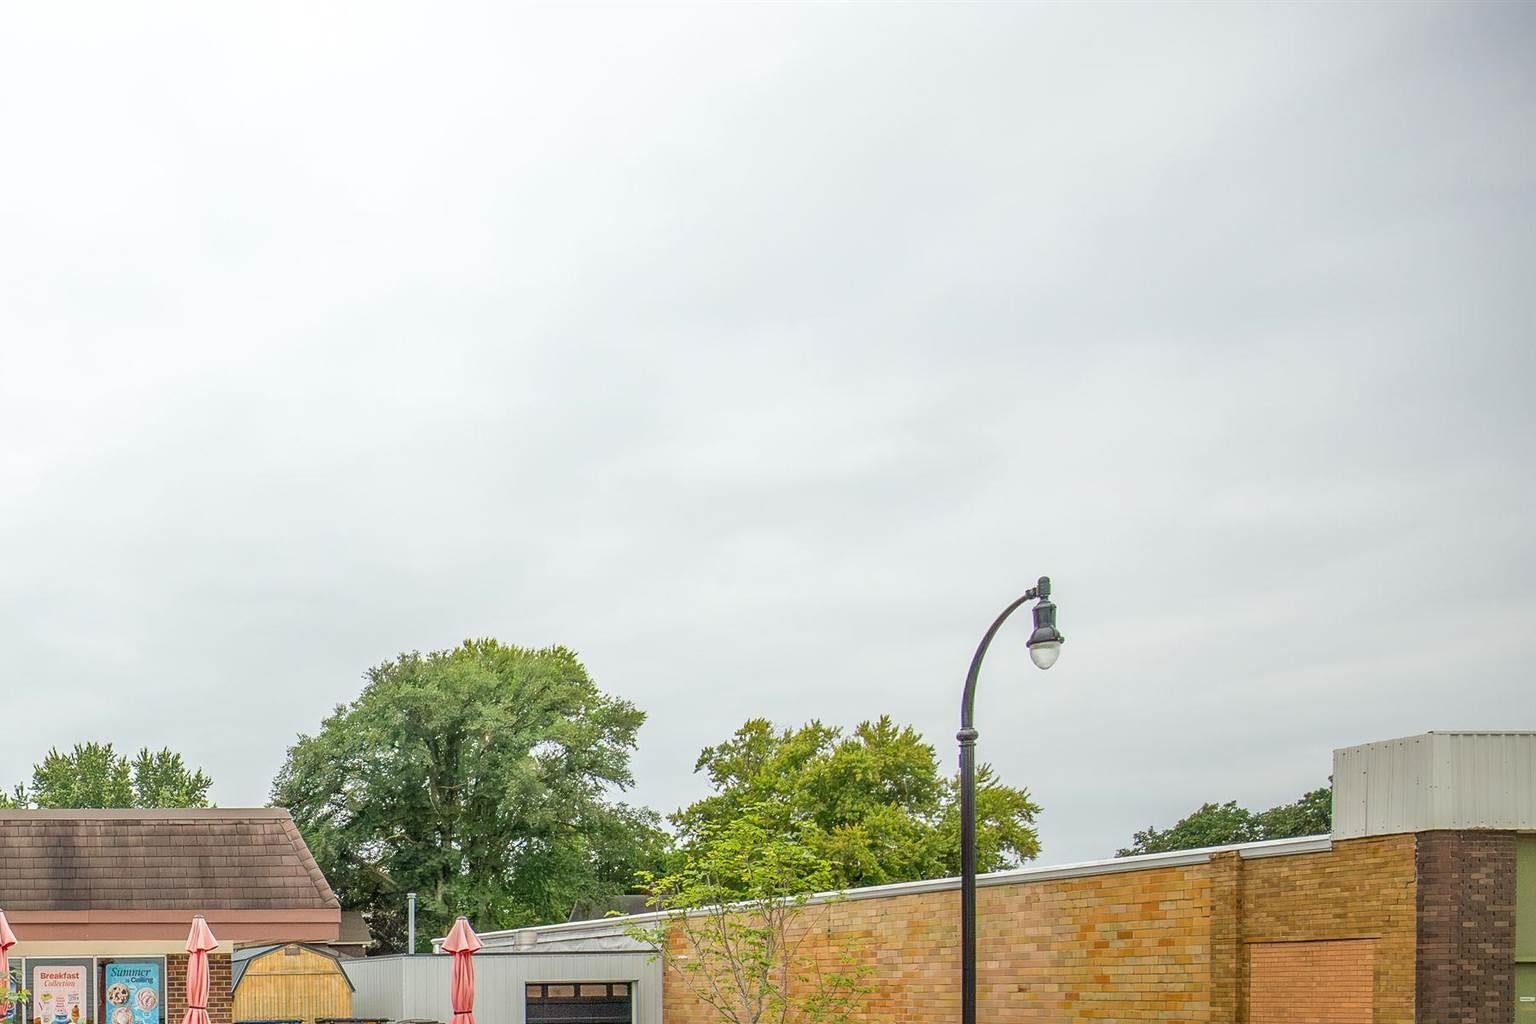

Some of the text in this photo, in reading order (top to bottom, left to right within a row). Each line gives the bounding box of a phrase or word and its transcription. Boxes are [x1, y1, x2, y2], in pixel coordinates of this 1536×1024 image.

[40, 972, 80, 980] Breakfast
[111, 967, 152, 977] Summer
[44, 980, 76, 988] Collection
